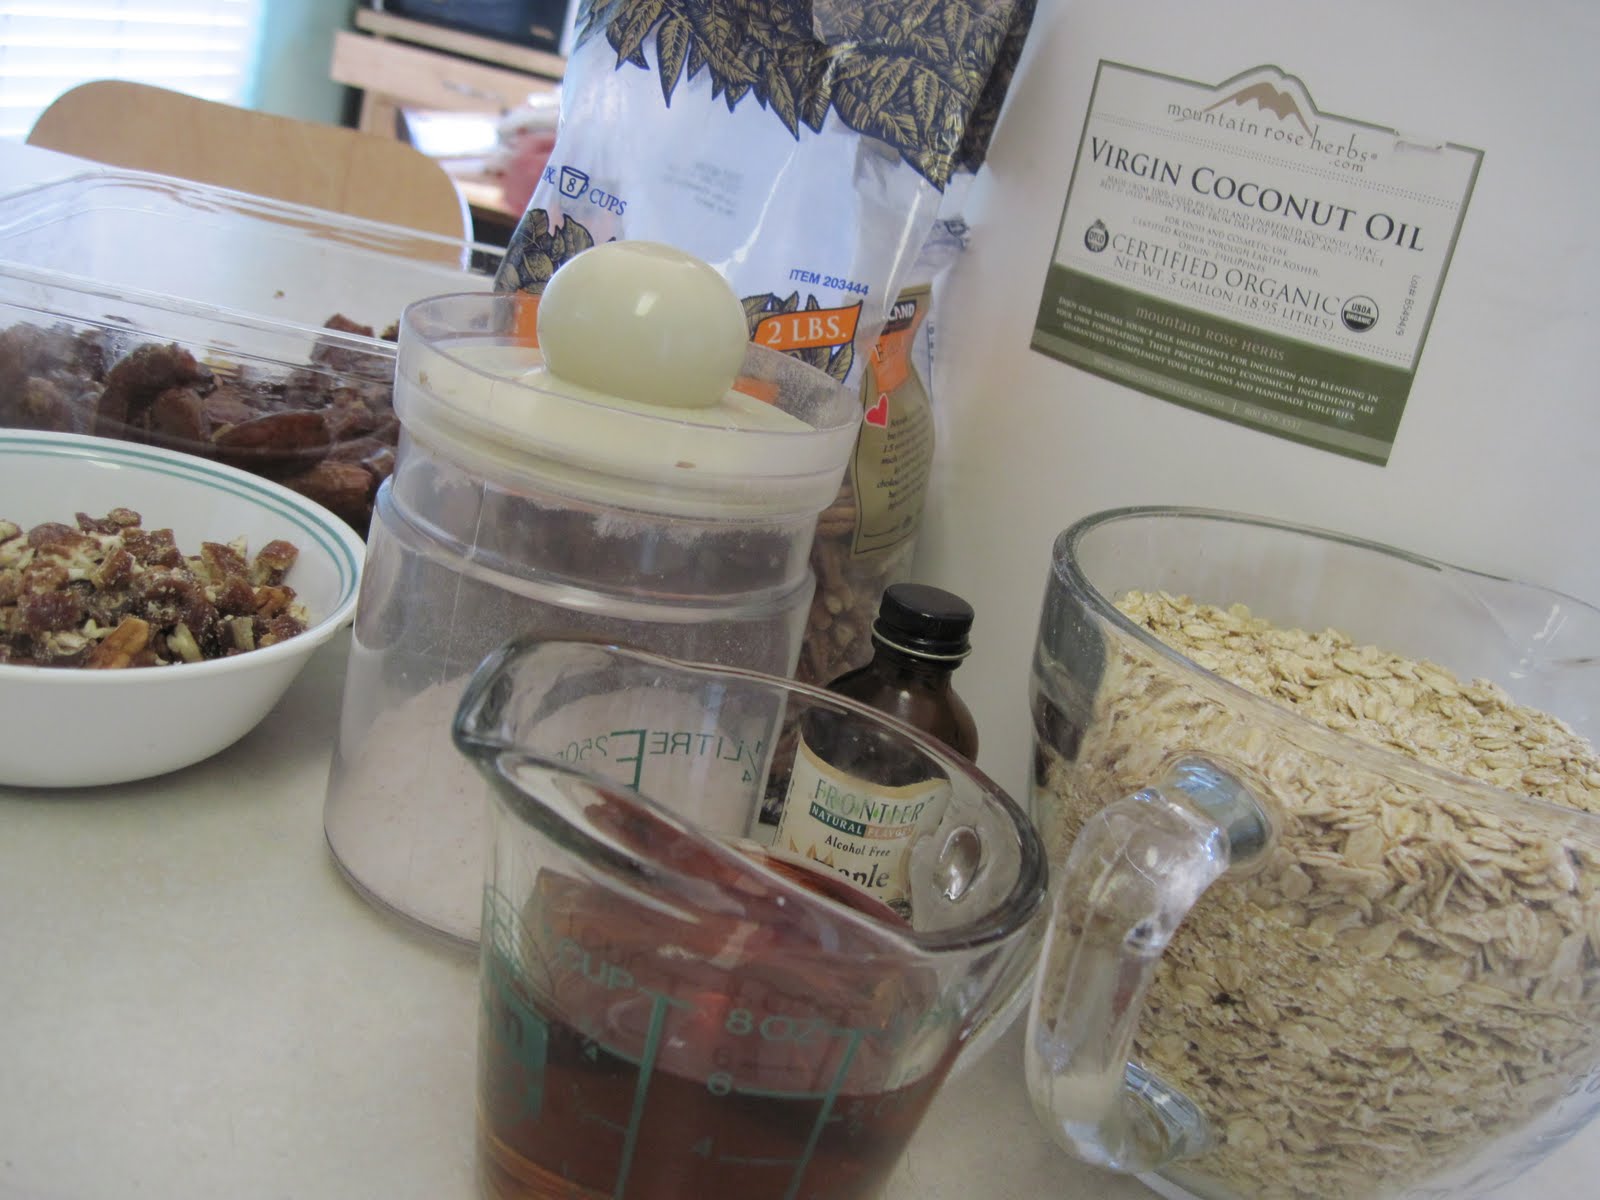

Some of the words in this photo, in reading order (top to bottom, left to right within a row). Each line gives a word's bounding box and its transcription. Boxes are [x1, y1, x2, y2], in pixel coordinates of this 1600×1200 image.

[1167, 103, 1257, 135] mountain
[1263, 126, 1310, 145] rose
[1309, 123, 1367, 161] herbs
[589, 188, 628, 216] CUPS
[1092, 136, 1181, 185] VIRGIN
[1191, 167, 1355, 230] COCONUT
[1365, 213, 1423, 251] OIL
[1170, 194, 1193, 206] COLD
[1230, 211, 1250, 221] AND
[1251, 217, 1302, 236] UNREFINED
[1303, 230, 1349, 248] COCONUT
[1182, 204, 1204, 216] YEARS
[1207, 211, 1231, 224] FROM
[1233, 218, 1255, 231] DATE
[1164, 215, 1179, 226] FOR
[1207, 227, 1225, 238] AND
[1226, 233, 1270, 252] COSMETIC
[1271, 245, 1287, 256] USE
[1251, 250, 1280, 265] EARTH
[789, 269, 821, 284] ITEM
[823, 275, 869, 296] 203444
[1112, 234, 1218, 279] CERTIFIED
[1224, 269, 1339, 315] ORGANIC
[1113, 255, 1138, 272] NET
[1168, 272, 1176, 284] 5
[1179, 278, 1233, 302] GALLON
[1135, 306, 1200, 336] mountain
[1346, 312, 1373, 325] ORGANIC
[1351, 303, 1371, 314] USDA
[767, 321, 782, 344] 2
[792, 315, 847, 342] LBS.
[1062, 322, 1105, 342] GUARANTEED
[1116, 342, 1165, 363] COMPLEMENT
[1167, 359, 1187, 371] YOUR
[1189, 366, 1232, 385] CREATIONS
[1234, 380, 1253, 391] AND
[1255, 386, 1303, 406] HANDMADE
[1073, 314, 1090, 325] OWN
[1148, 340, 1171, 354] THESE
[1173, 348, 1214, 367] PRACTICAL
[1217, 363, 1236, 374] AND
[1239, 369, 1293, 391] ECONOMICAL
[1297, 386, 1355, 408] INGREDIENTS
[1357, 404, 1374, 414] ARE
[1077, 304, 1092, 315] OUR
[1094, 310, 1123, 326] NATURAL
[1125, 321, 1153, 336] SOURCE
[1154, 331, 1173, 343] BULK
[1175, 338, 1228, 360] INGREDIENTS
[1230, 354, 1247, 366] FOR
[1249, 360, 1296, 379] INCLUSION
[1297, 375, 1318, 386] AND
[1320, 381, 1365, 399] BLENDING
[1367, 394, 1378, 403] IN
[814, 778, 925, 825] FRONTIER
[811, 804, 863, 835] NATURAL
[824, 834, 865, 856] Alcohol
[869, 846, 891, 857] Free
[725, 1008, 754, 1035] 8
[706, 1071, 734, 1097] 6
